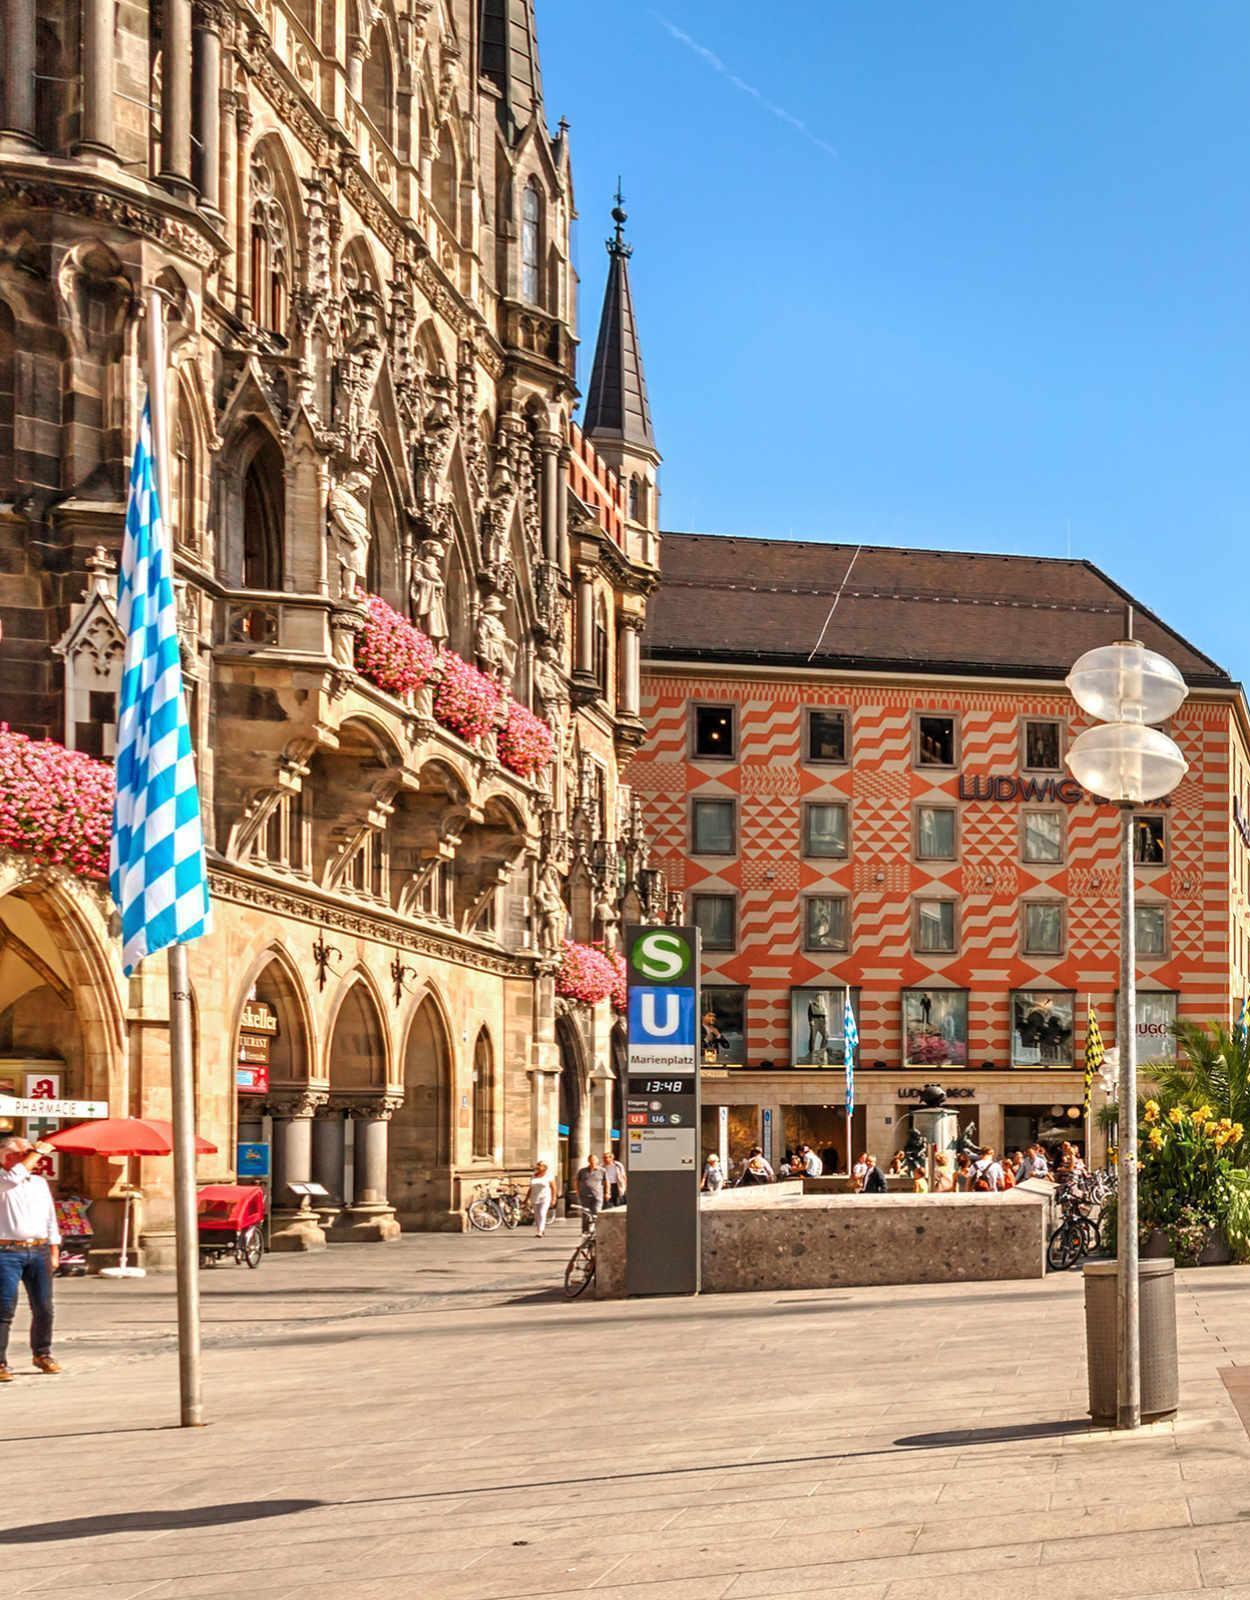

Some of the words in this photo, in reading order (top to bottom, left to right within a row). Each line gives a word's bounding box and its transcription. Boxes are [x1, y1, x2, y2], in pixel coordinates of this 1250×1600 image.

[959, 774, 1084, 804] LUDWIG
[642, 934, 683, 978] S
[642, 993, 680, 1037] U
[630, 1055, 694, 1067] Marienplatz
[645, 1081, 683, 1093] 13:48
[651, 1114, 665, 1123] U6
